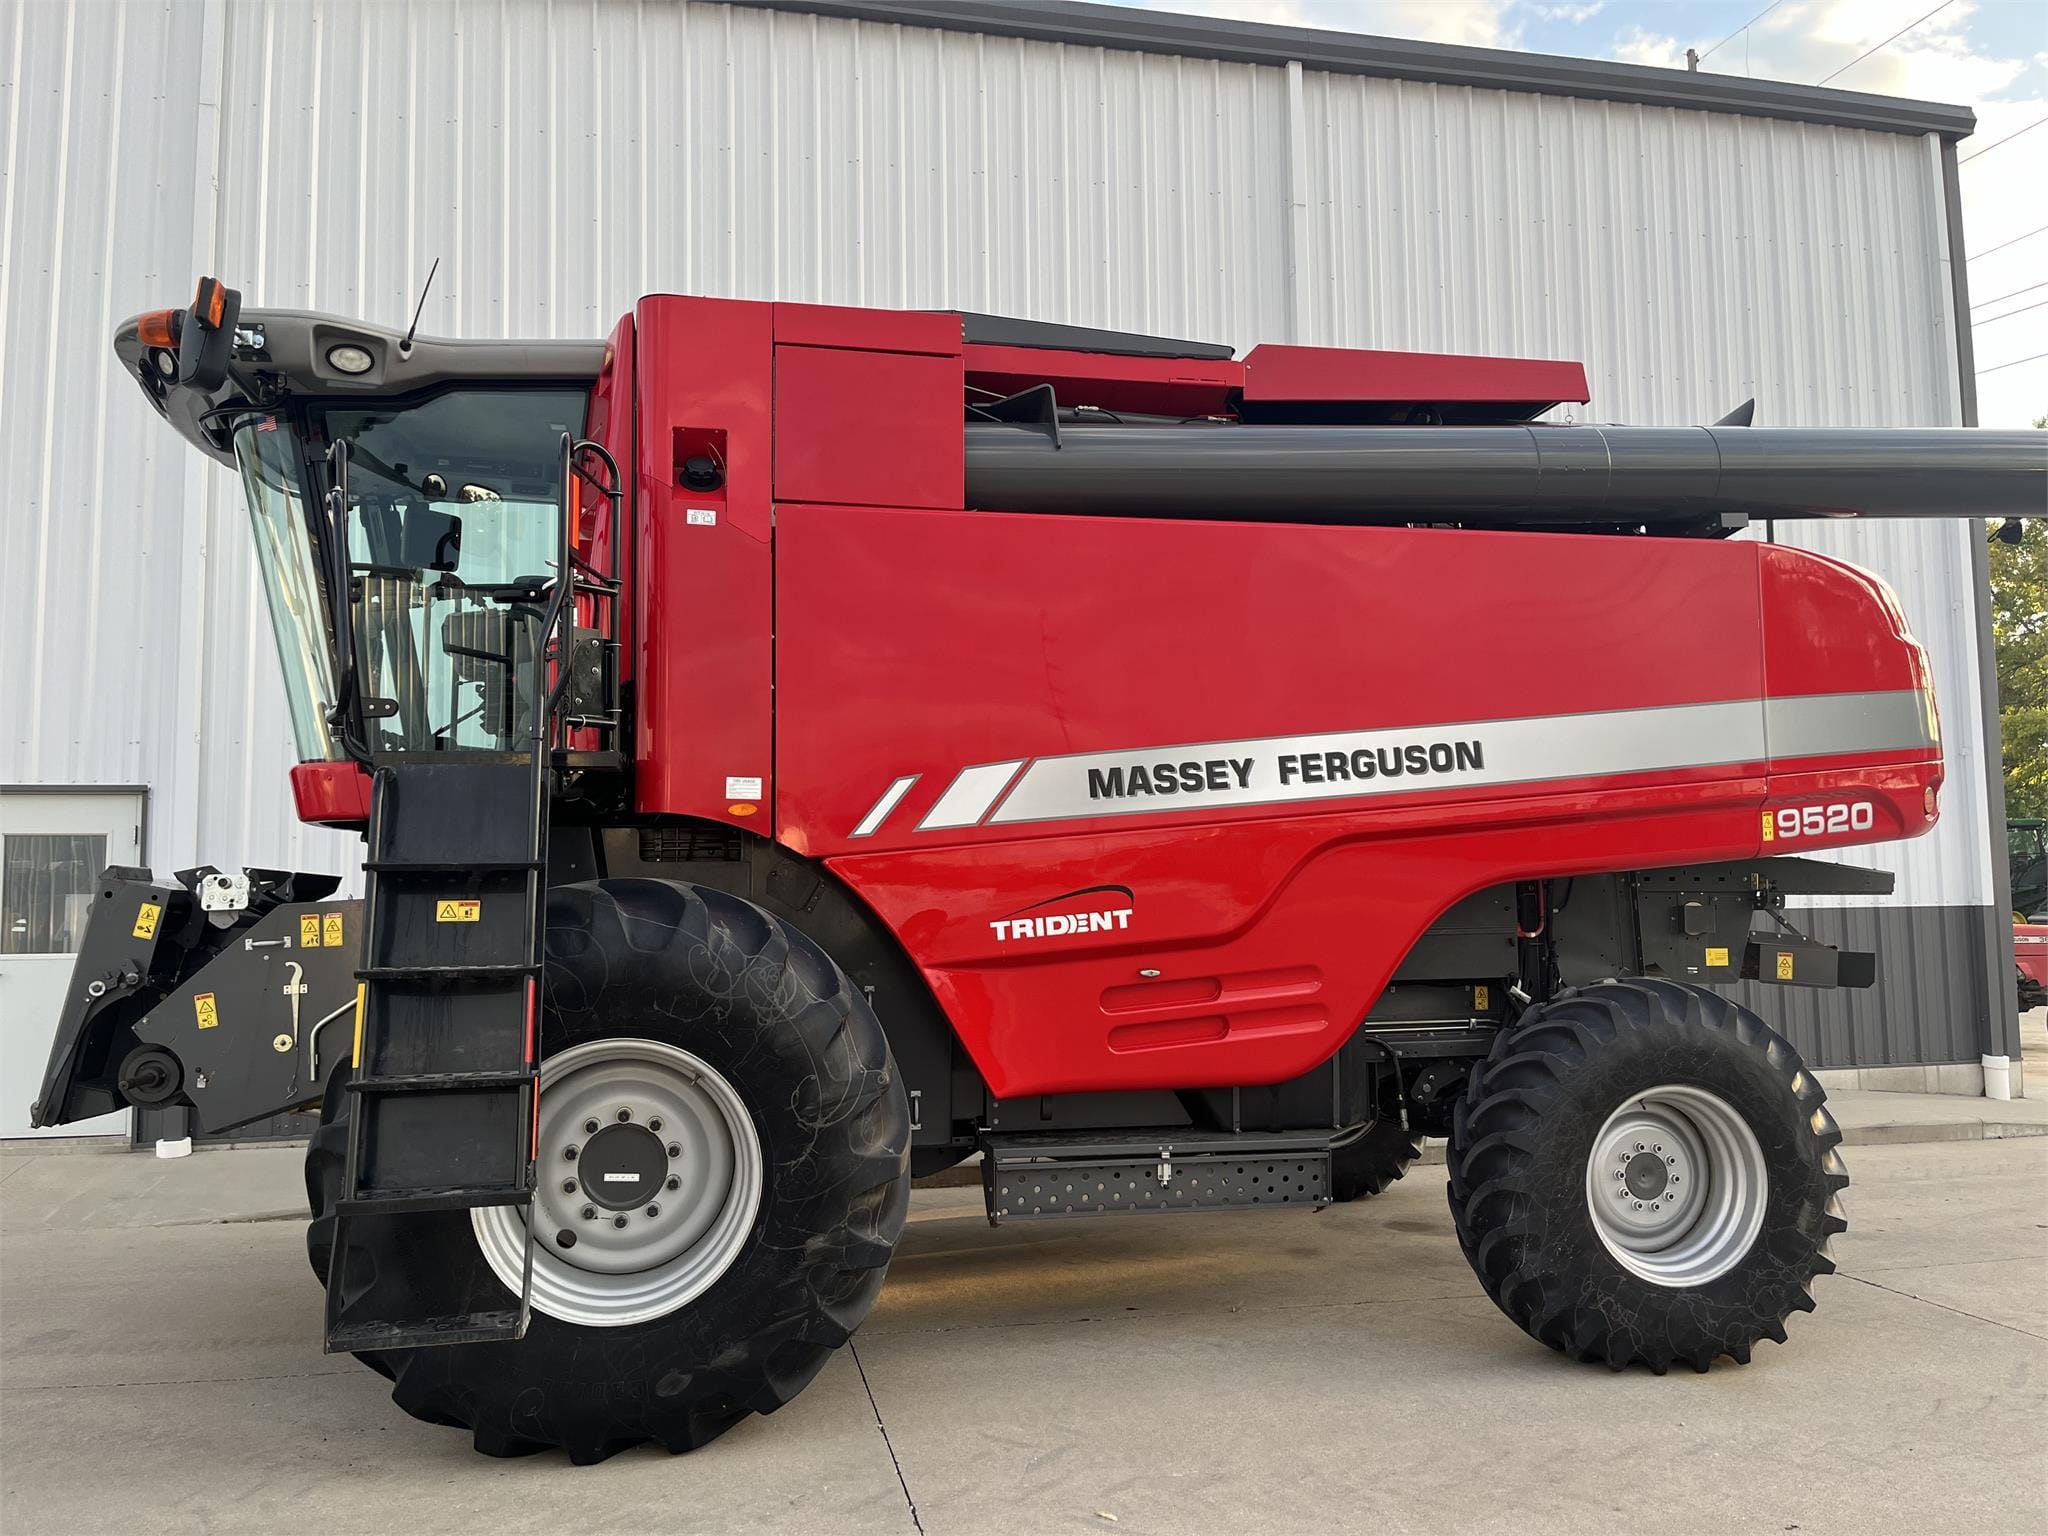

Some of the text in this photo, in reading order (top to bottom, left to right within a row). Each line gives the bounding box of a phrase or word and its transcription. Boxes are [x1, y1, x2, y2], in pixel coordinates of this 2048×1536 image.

[1087, 740, 1485, 799] MASSEY FERGUSON
[1777, 801, 1873, 839] 9520
[989, 908, 1133, 942] TRIDENT
